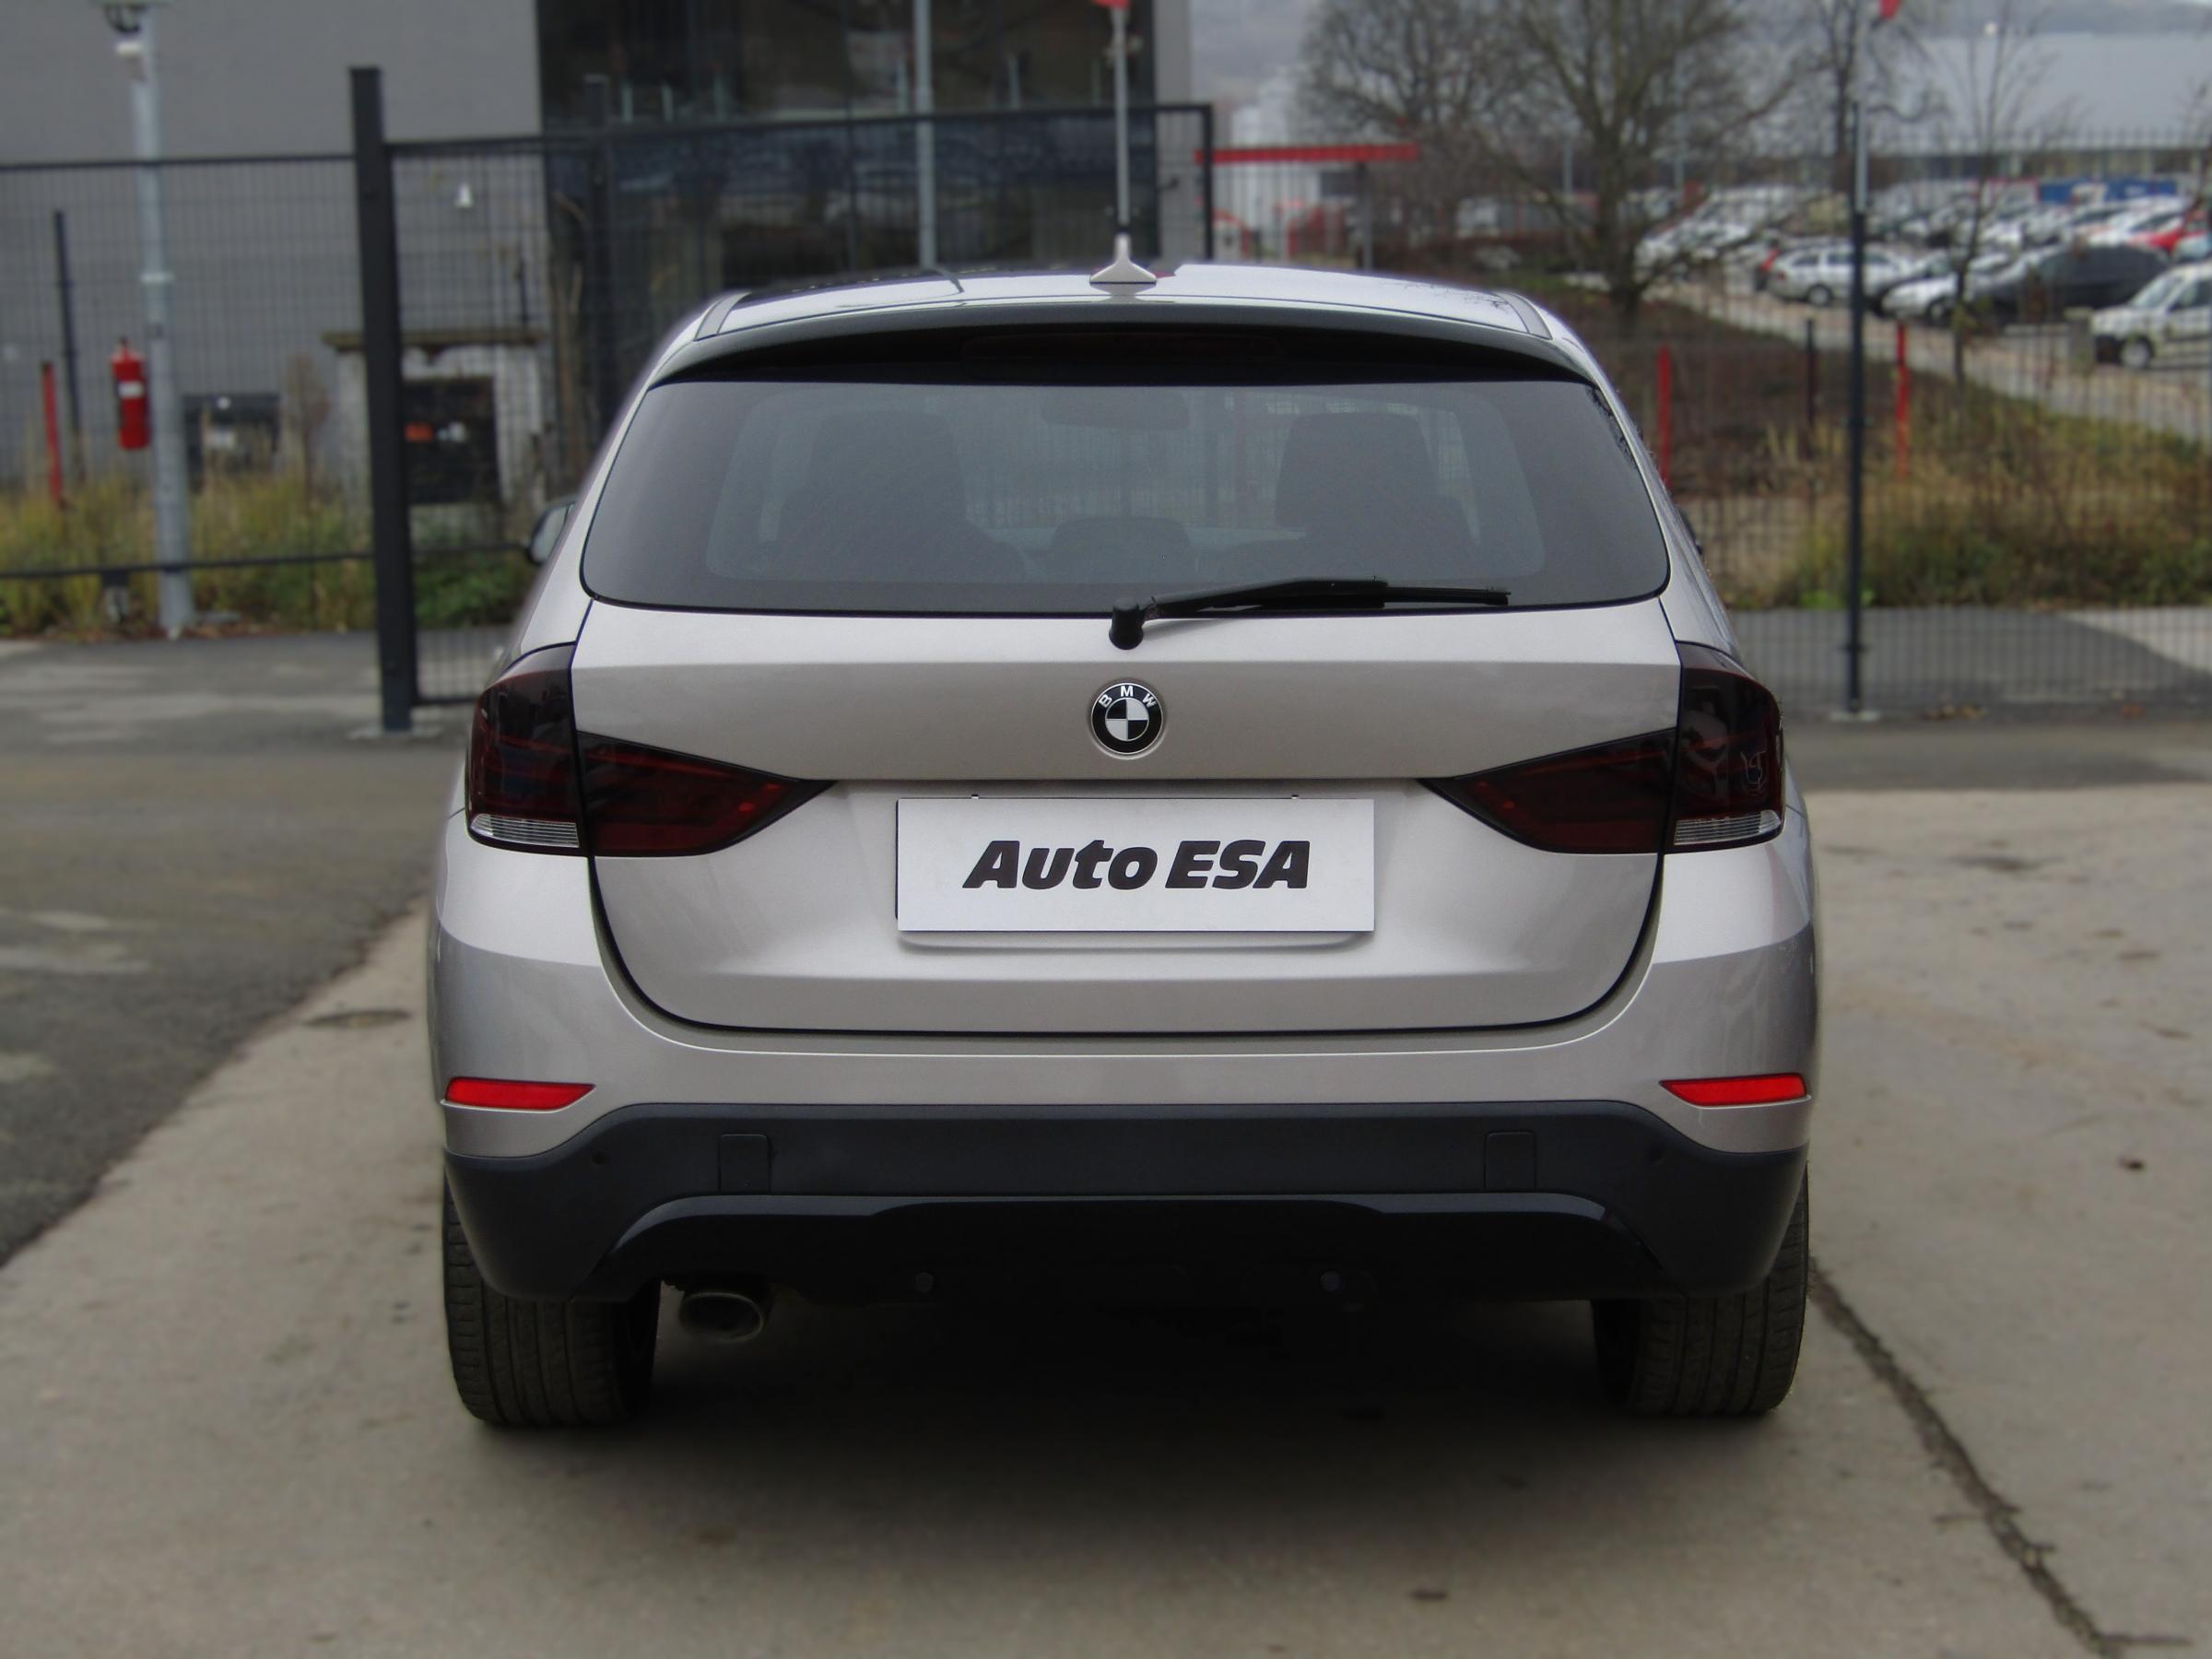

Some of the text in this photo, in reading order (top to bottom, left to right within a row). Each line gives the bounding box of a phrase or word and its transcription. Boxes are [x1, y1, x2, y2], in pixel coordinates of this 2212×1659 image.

[1099, 685, 1158, 709] BMW
[962, 840, 1311, 890] Auto ESA
